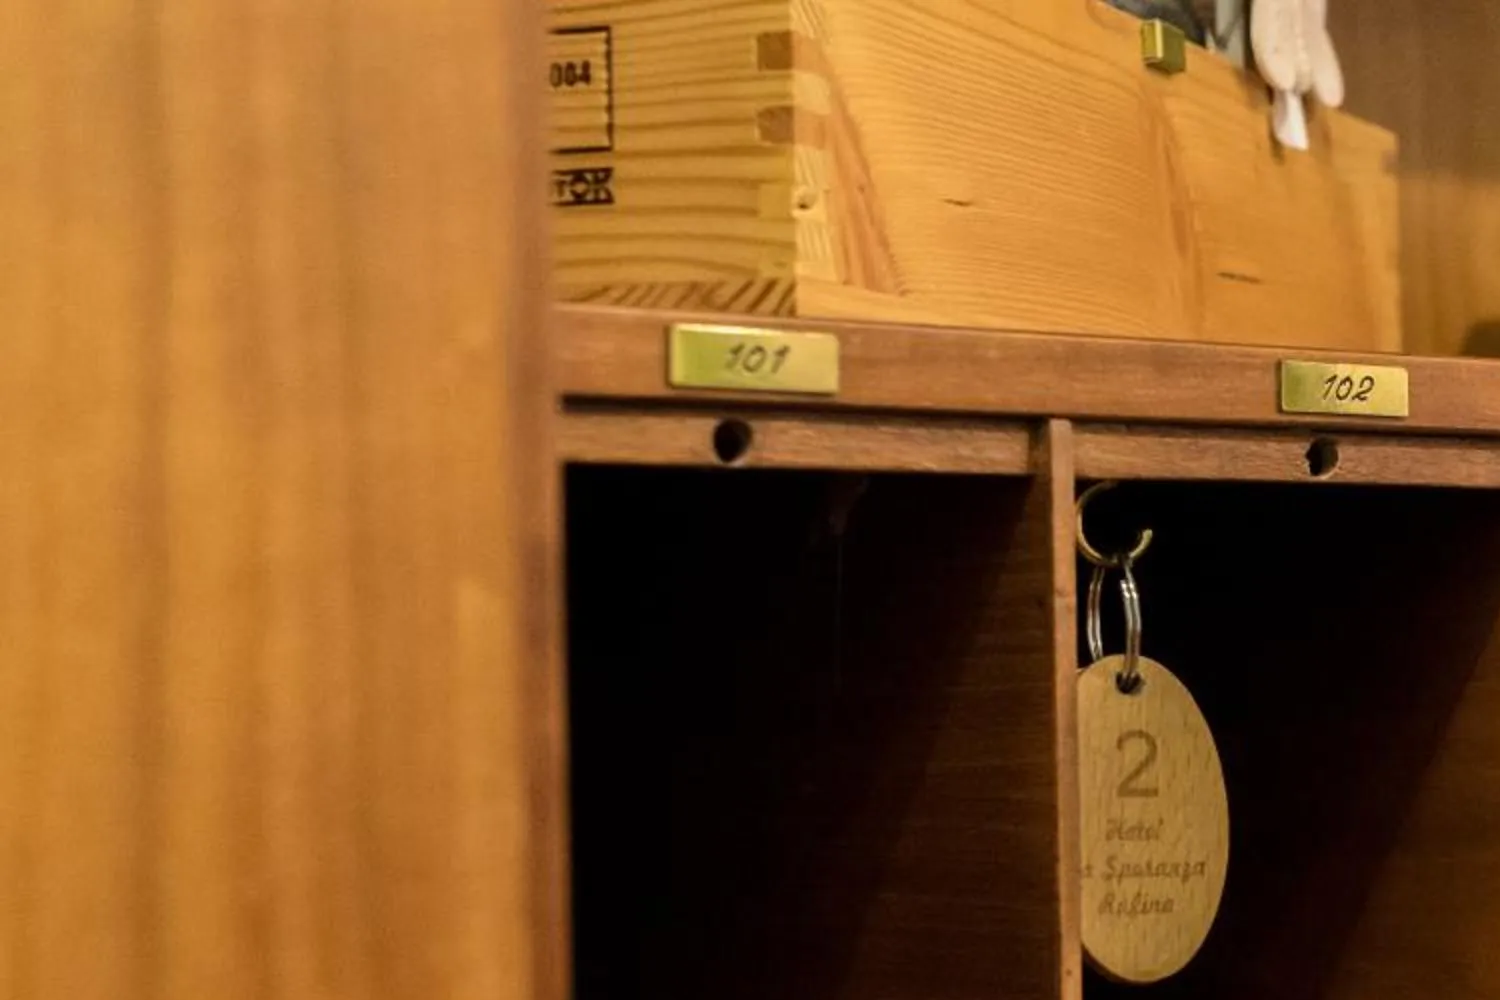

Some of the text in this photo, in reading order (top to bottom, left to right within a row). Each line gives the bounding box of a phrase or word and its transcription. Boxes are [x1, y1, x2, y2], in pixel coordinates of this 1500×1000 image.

[725, 343, 790, 374] 101
[1322, 373, 1375, 401] 102
[1116, 729, 1159, 798] 2
